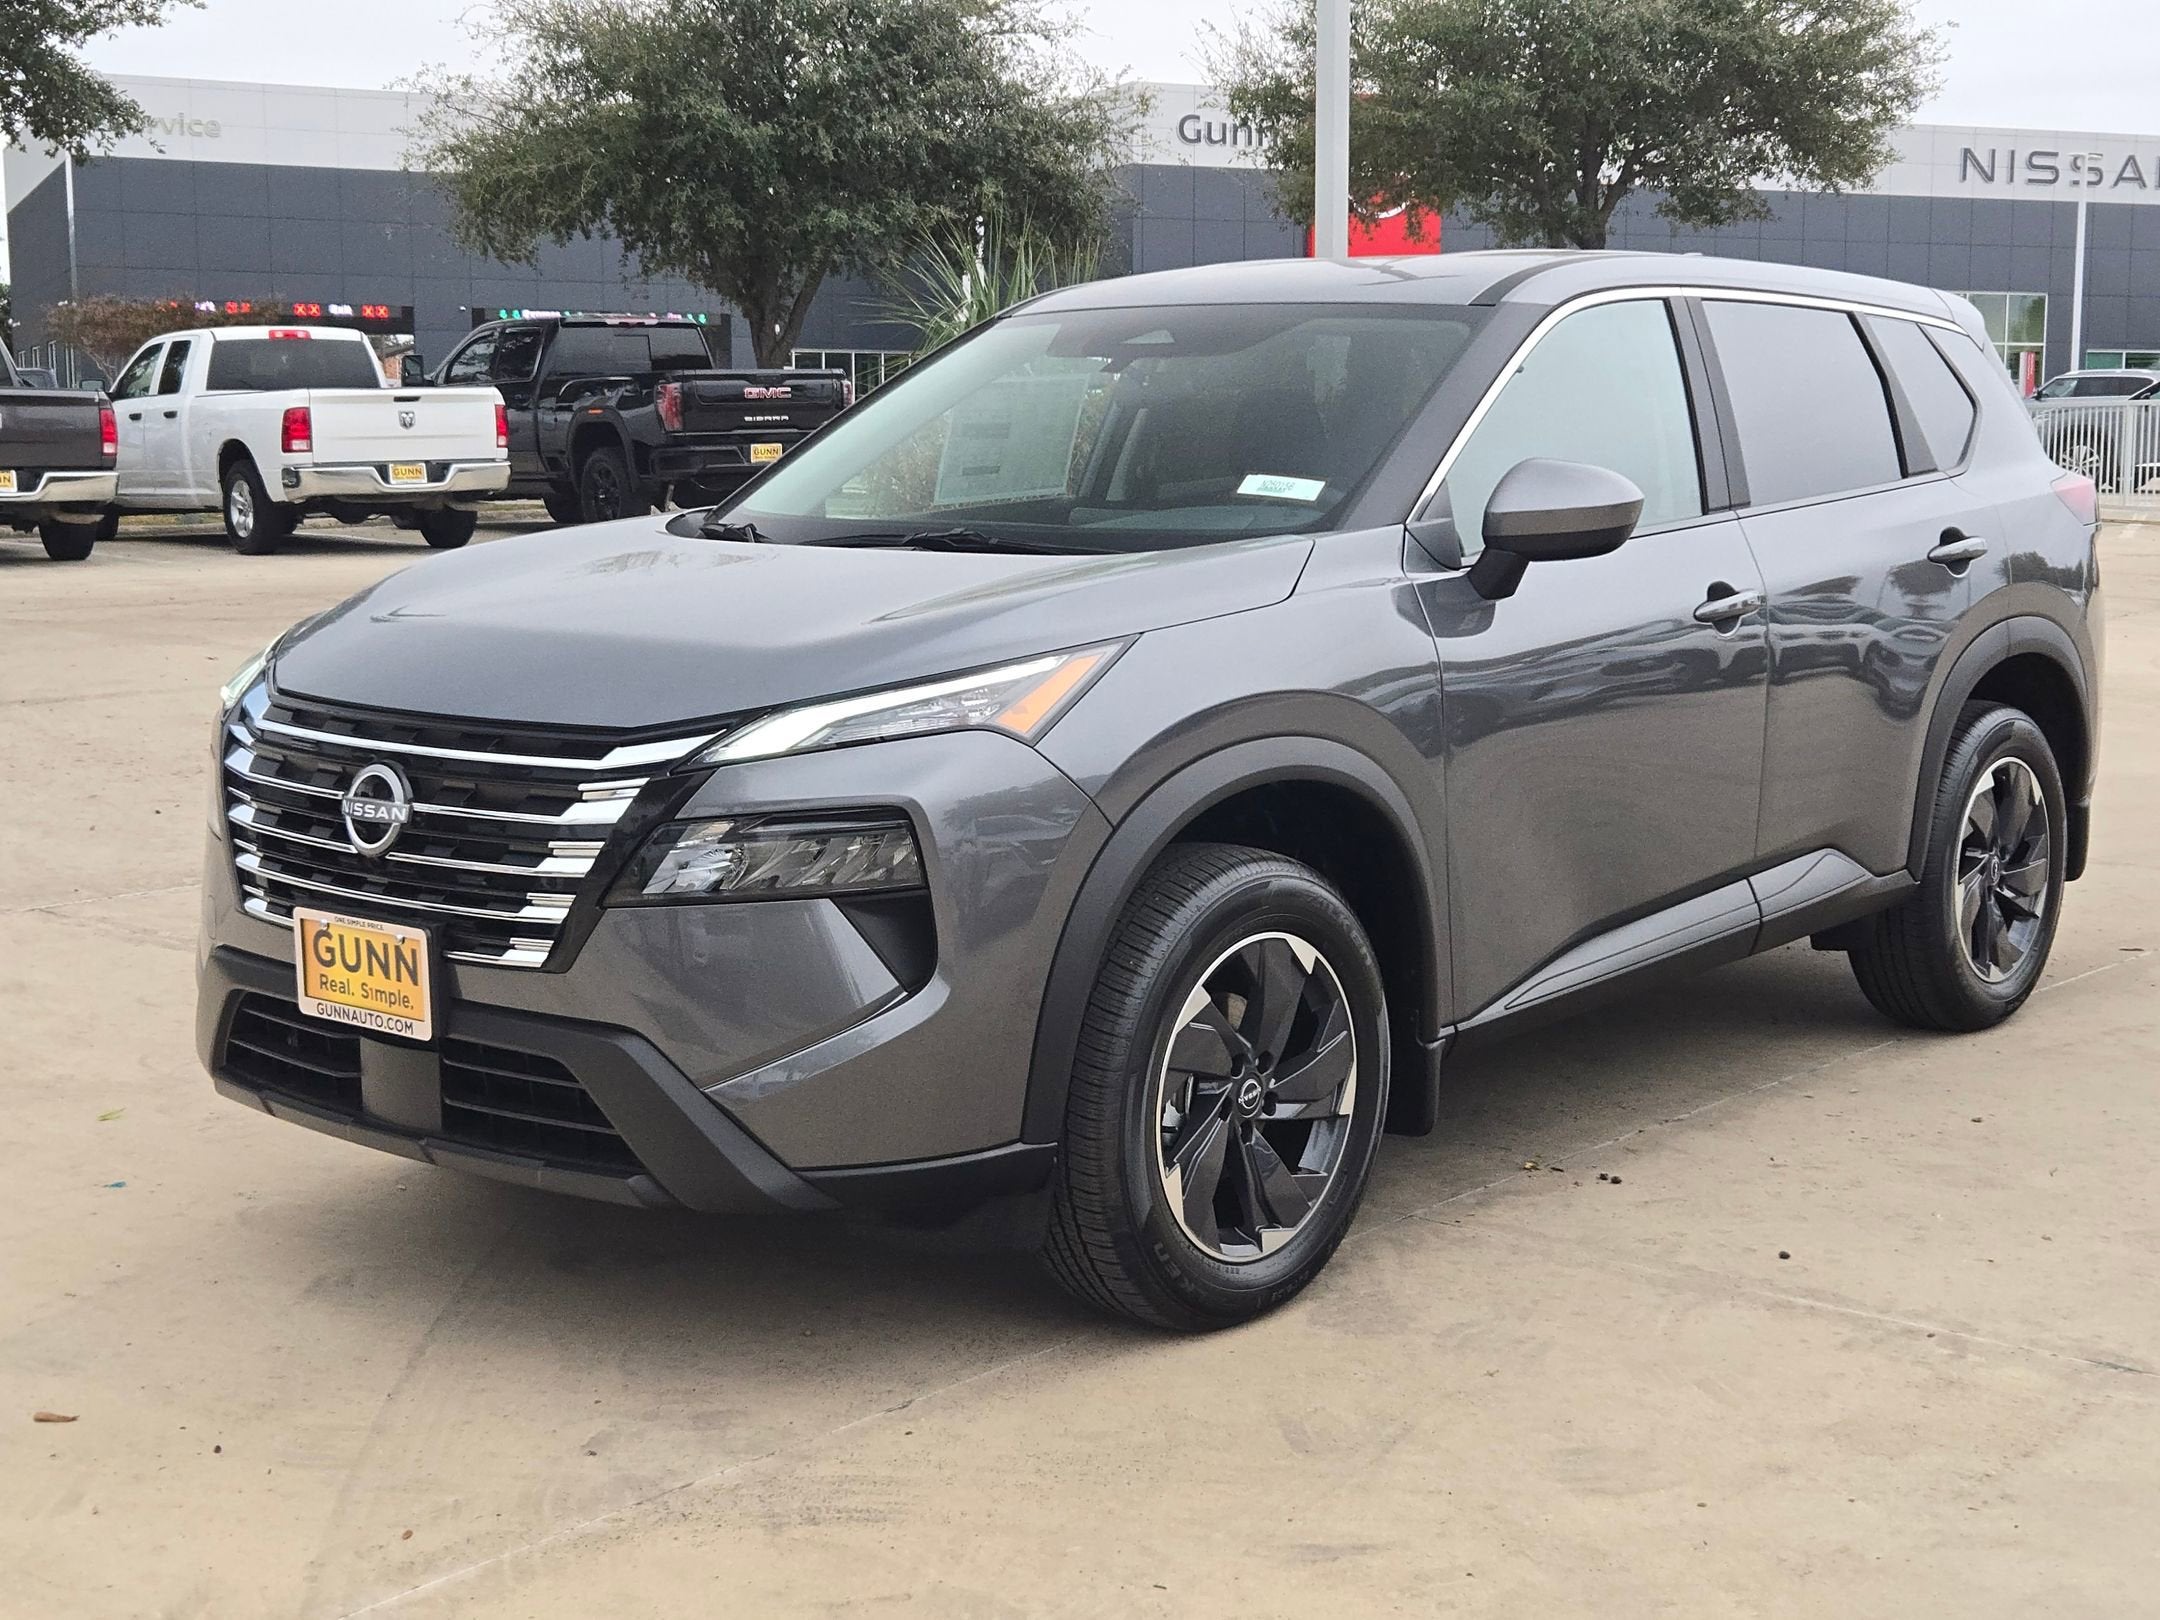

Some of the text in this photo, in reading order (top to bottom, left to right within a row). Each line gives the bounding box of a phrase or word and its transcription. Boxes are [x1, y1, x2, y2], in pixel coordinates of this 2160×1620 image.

[1960, 147, 2160, 189] NISSA
[744, 387, 791, 399] GMC
[753, 448, 779, 456] GUNN
[393, 467, 422, 476] GUNN
[342, 799, 406, 821] NISSAN
[313, 928, 419, 986] GUNN
[320, 973, 355, 996] Real.
[317, 1002, 414, 1036] GUNNAUTO.COM
